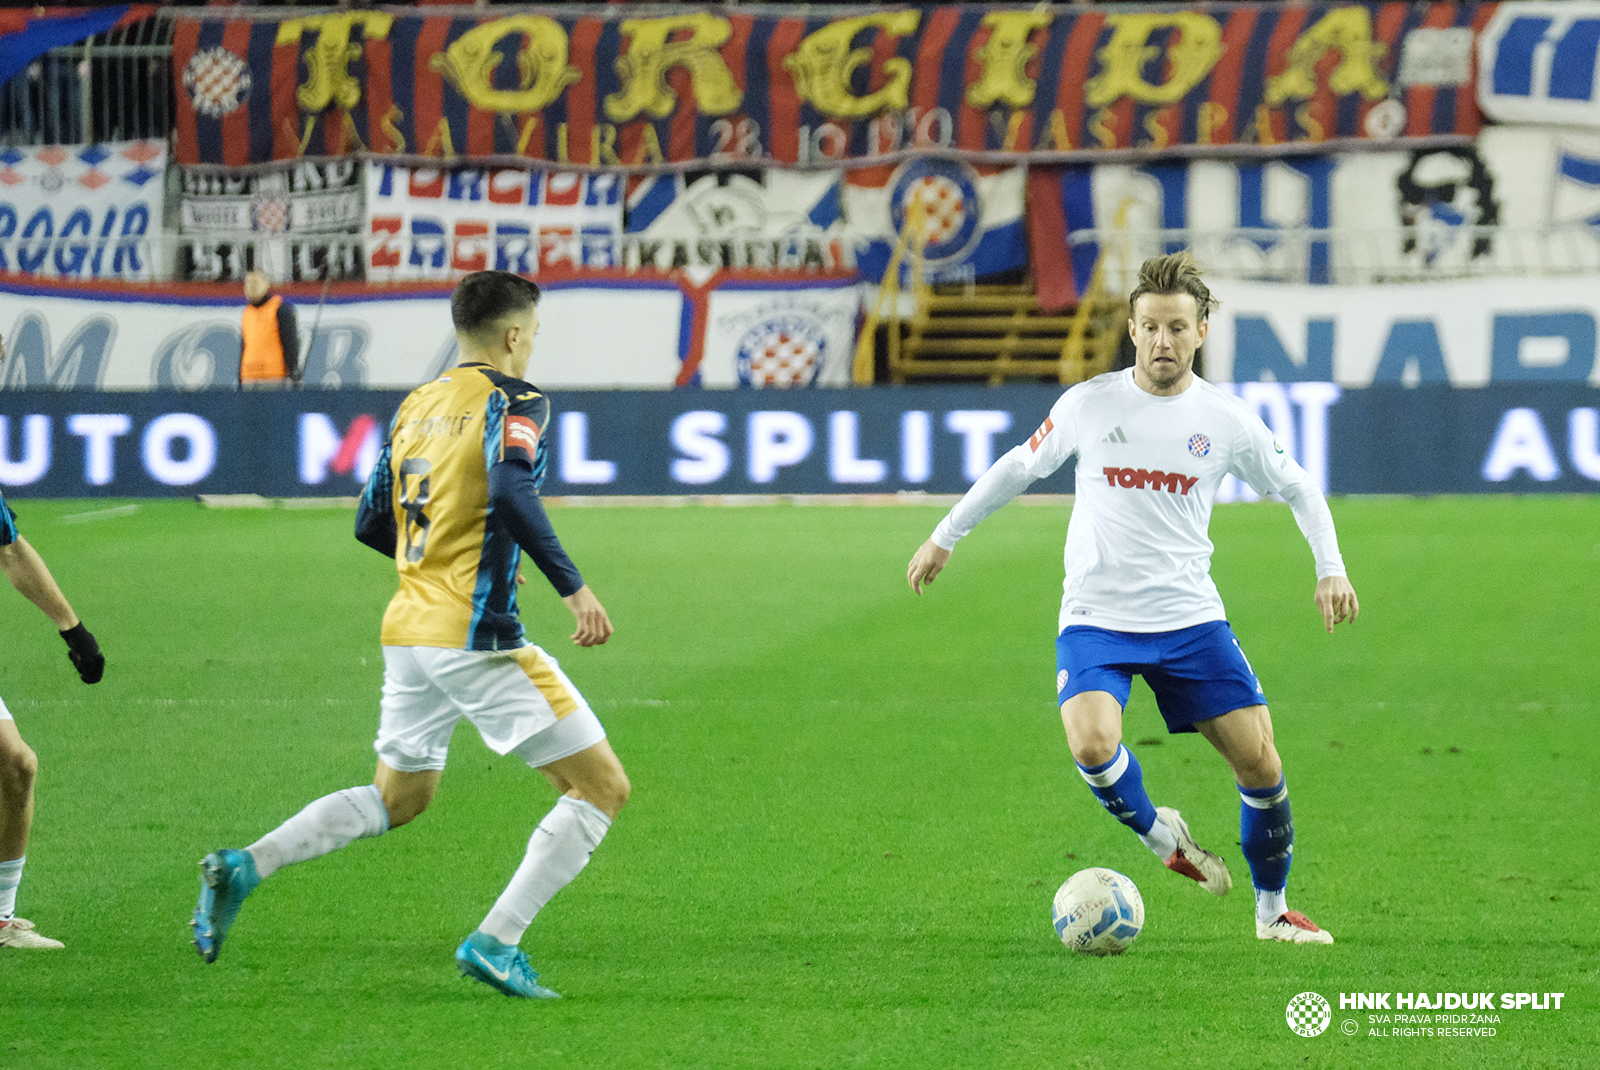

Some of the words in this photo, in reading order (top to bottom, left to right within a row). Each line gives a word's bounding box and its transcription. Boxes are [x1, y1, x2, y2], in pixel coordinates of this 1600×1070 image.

[276, 11, 1389, 120] TORCIDA
[669, 408, 1014, 485] SPLIT
[1102, 466, 1200, 497] TOMMY
